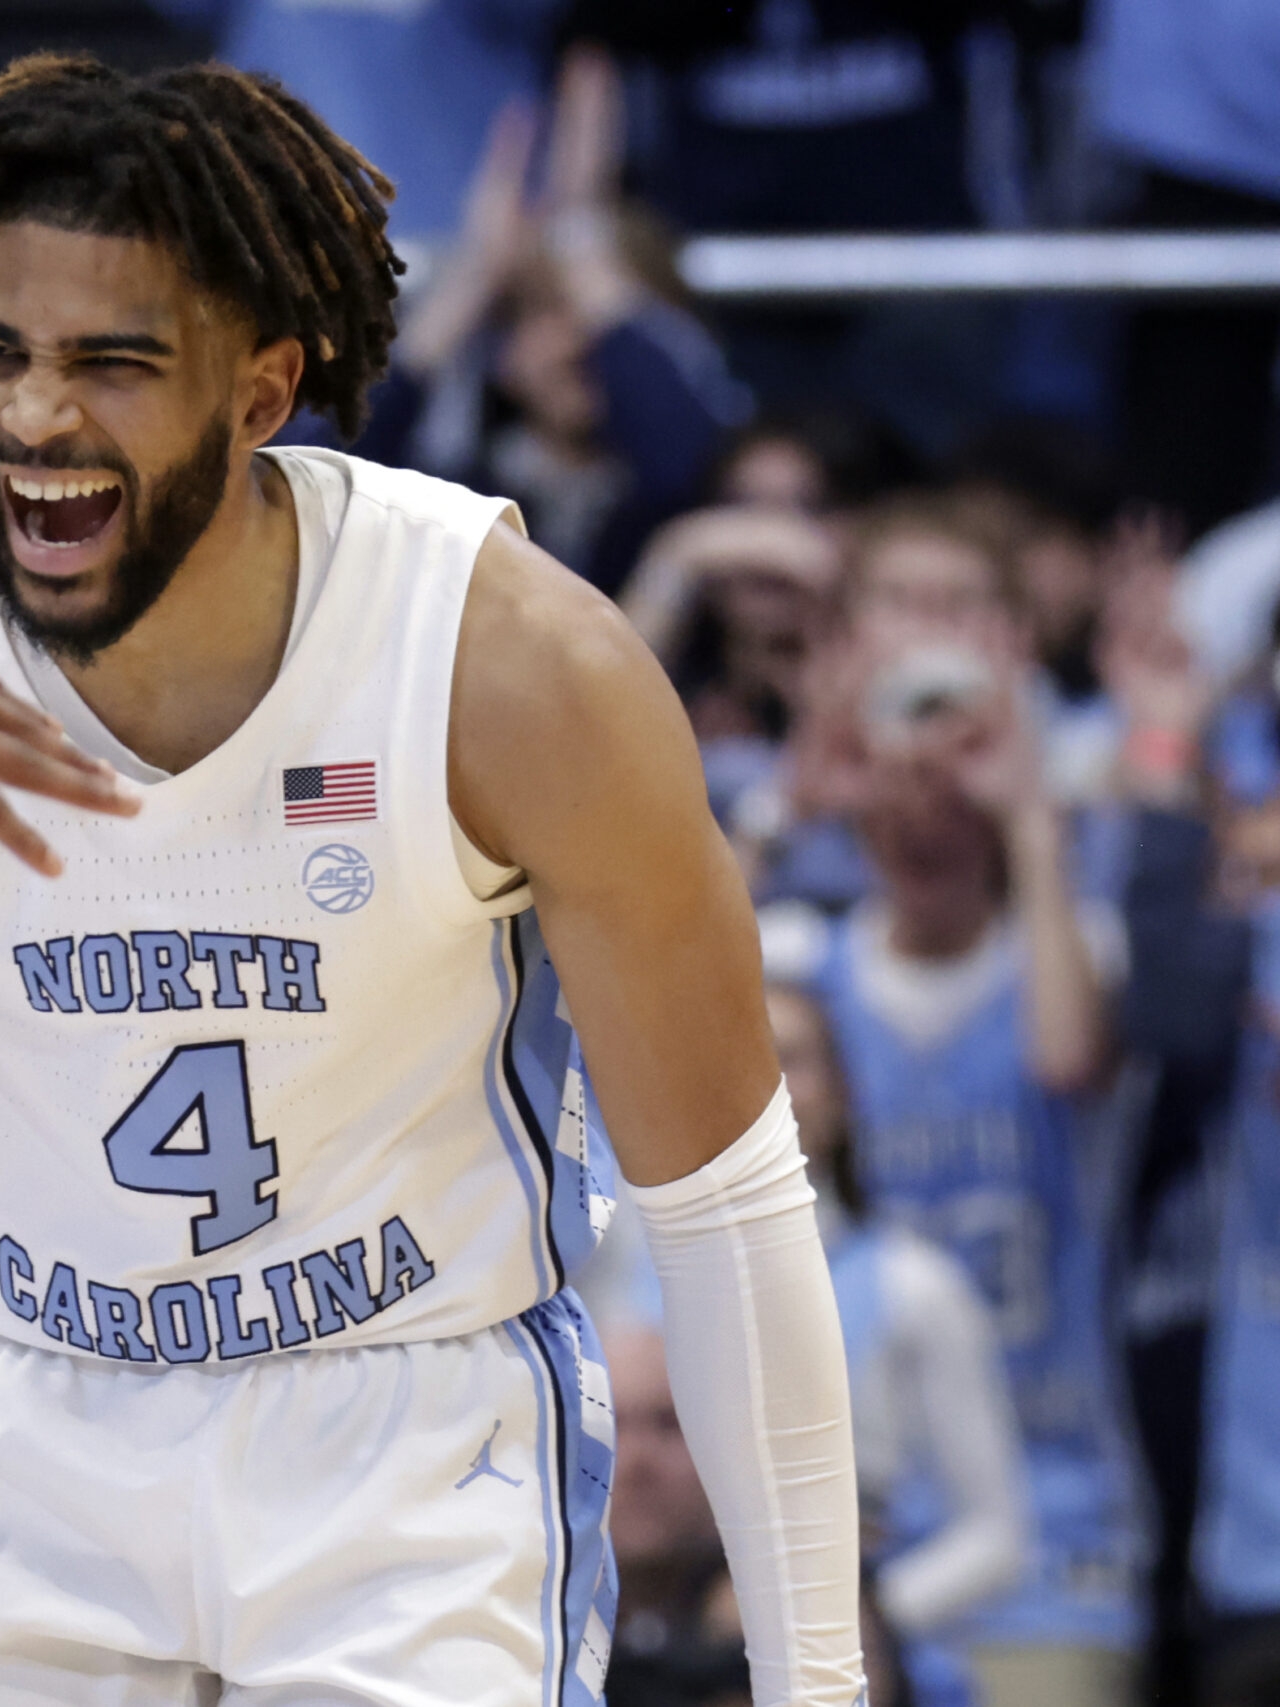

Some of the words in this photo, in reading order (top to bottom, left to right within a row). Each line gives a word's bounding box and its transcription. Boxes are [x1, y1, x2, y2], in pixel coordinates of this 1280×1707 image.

[309, 864, 370, 888] ACC
[13, 930, 326, 1013] NORTH
[103, 1039, 280, 1256] 4
